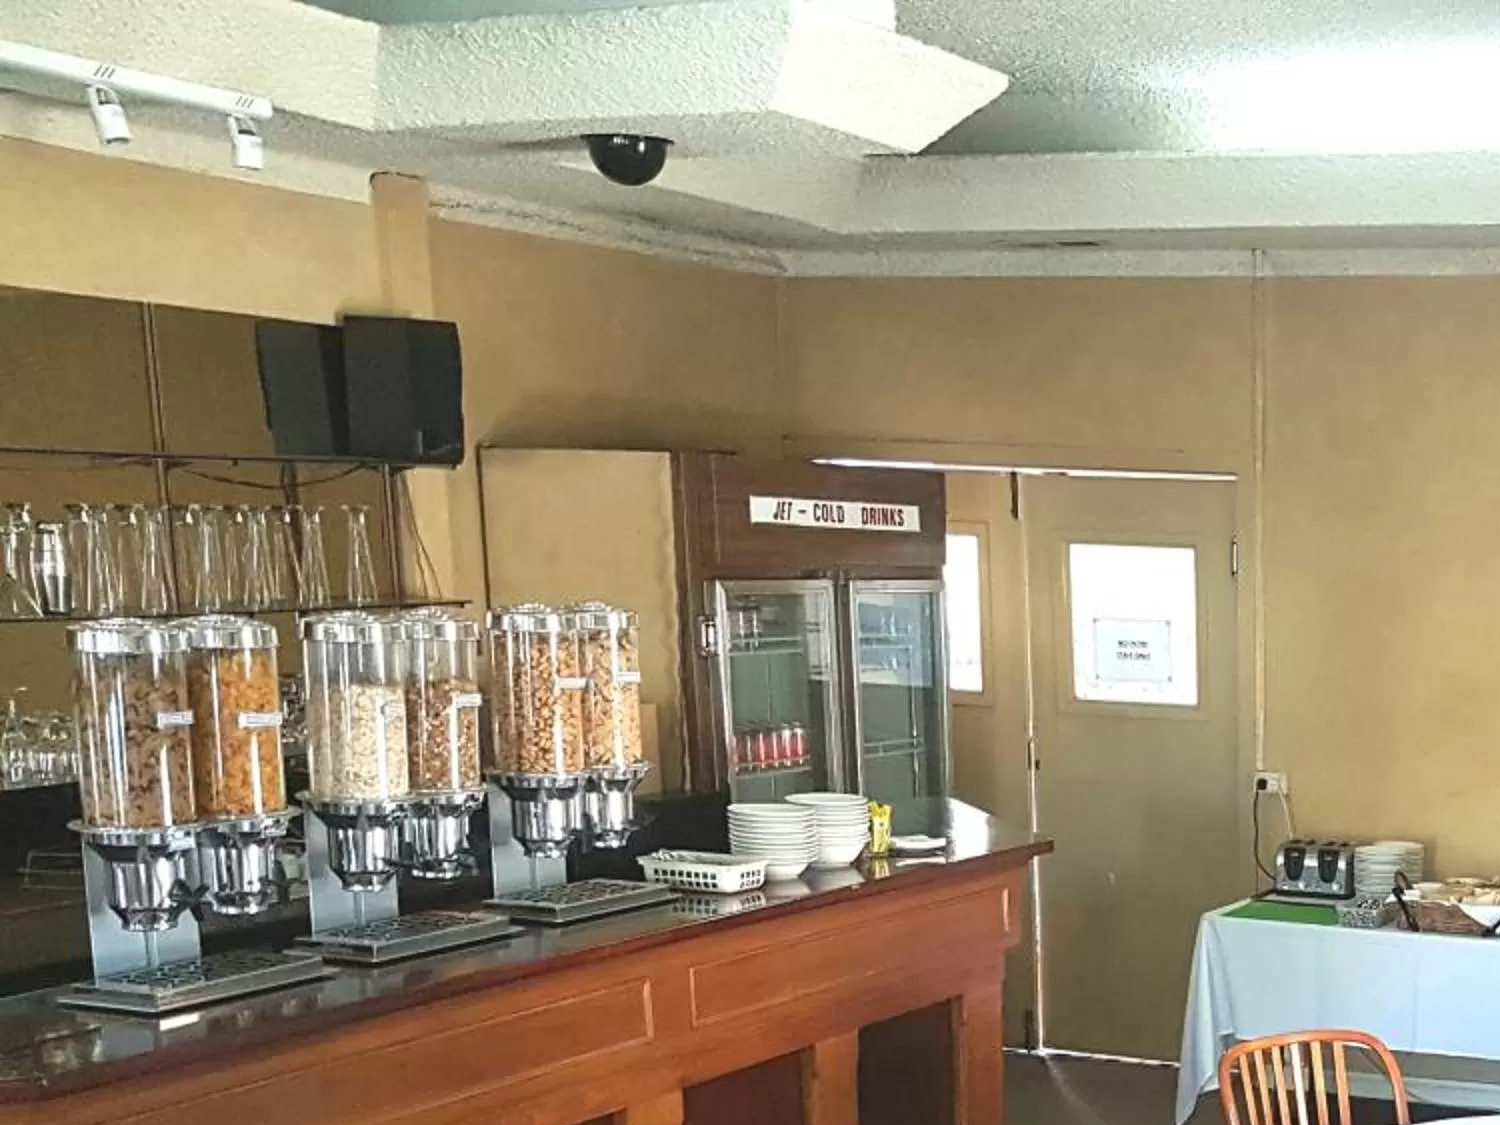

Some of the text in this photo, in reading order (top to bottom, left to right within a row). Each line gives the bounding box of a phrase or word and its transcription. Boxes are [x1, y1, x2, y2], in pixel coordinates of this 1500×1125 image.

[773, 501, 792, 520] JET
[813, 503, 845, 523] COLD
[861, 507, 904, 527] DRINKS
